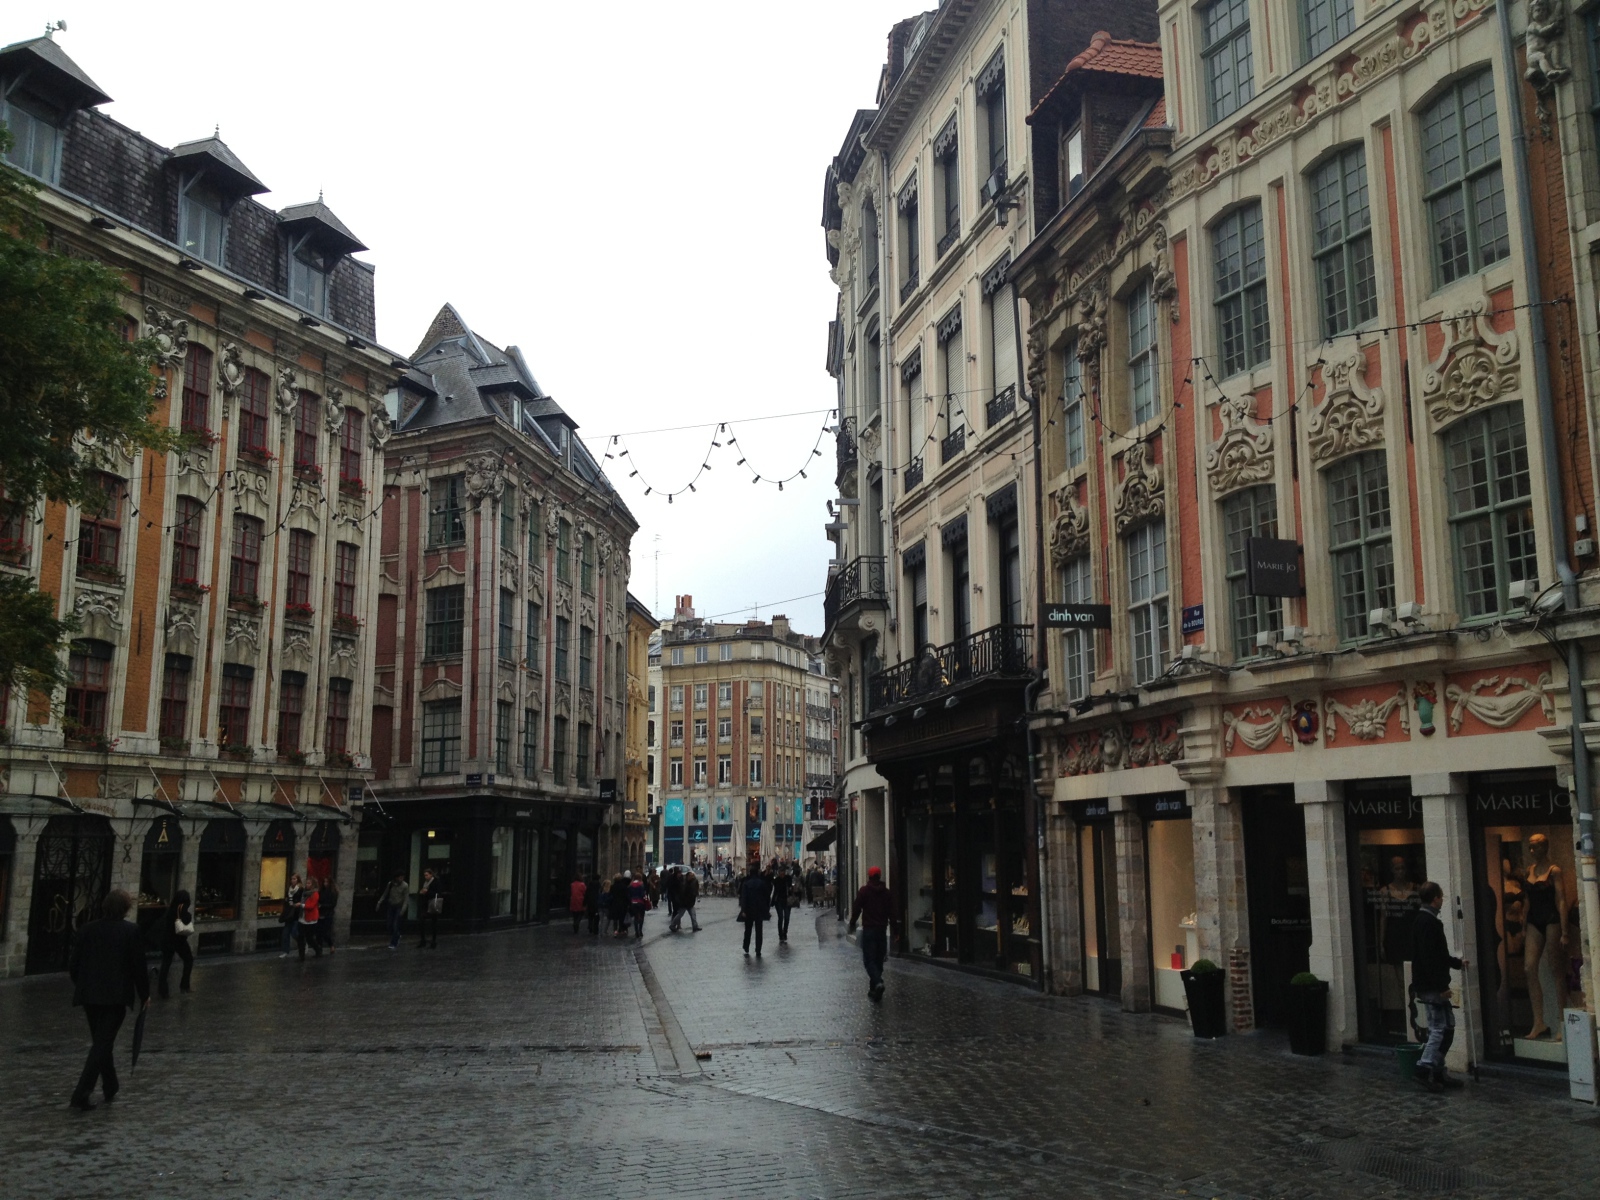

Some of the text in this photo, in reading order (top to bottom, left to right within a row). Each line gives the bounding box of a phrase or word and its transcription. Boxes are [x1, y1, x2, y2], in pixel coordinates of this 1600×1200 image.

[1048, 608, 1095, 621] dinh van
[1085, 803, 1107, 816] dinh van
[1155, 797, 1181, 812] dinh van
[1348, 799, 1402, 816] MARIE
[1476, 793, 1541, 811] MARIE
